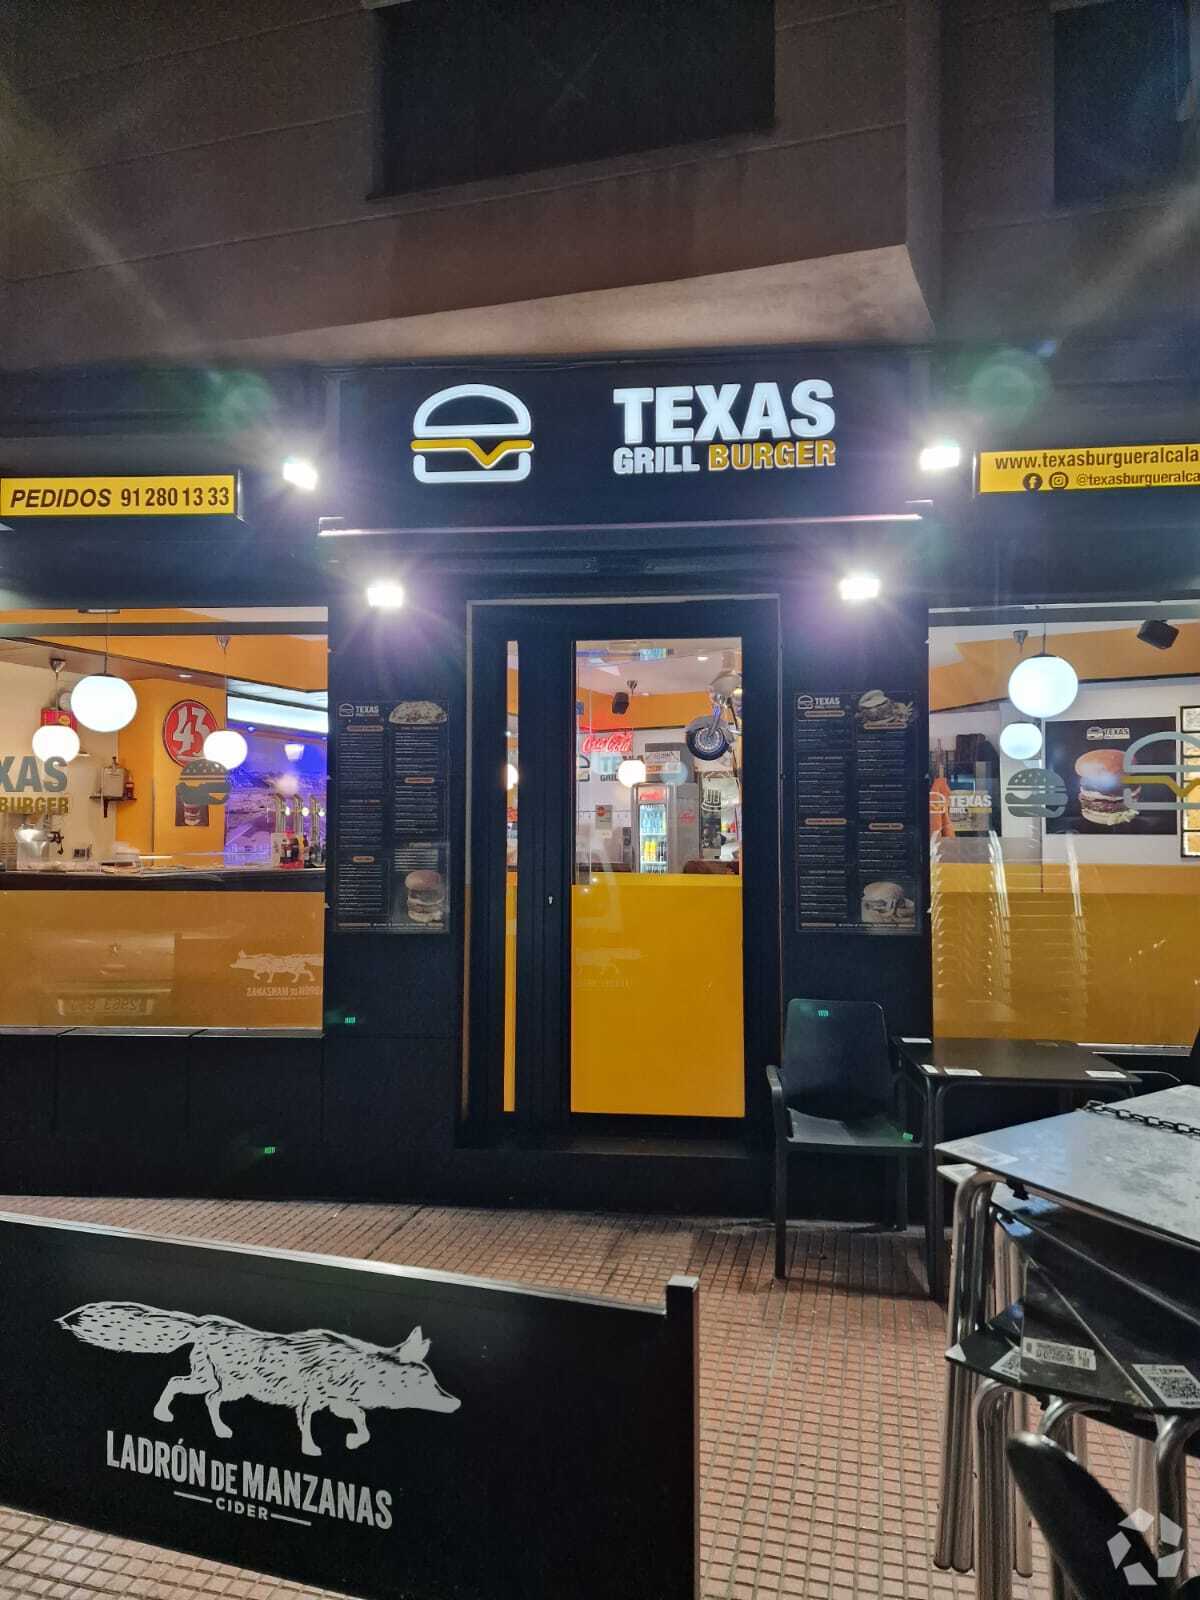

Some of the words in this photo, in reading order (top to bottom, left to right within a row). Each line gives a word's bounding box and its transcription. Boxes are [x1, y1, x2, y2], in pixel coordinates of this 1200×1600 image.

[613, 379, 835, 445] TEXAS
[613, 446, 700, 475] GRILL
[708, 440, 836, 472] BURGER
[995, 447, 1199, 470] www.texasburgueralcala
[10, 489, 112, 507] PEDIDOS
[106, 1430, 206, 1487] LADRÓN
[210, 1460, 238, 1495] DE
[242, 1461, 393, 1530] MANZANAS
[215, 1497, 268, 1521] CIDER
